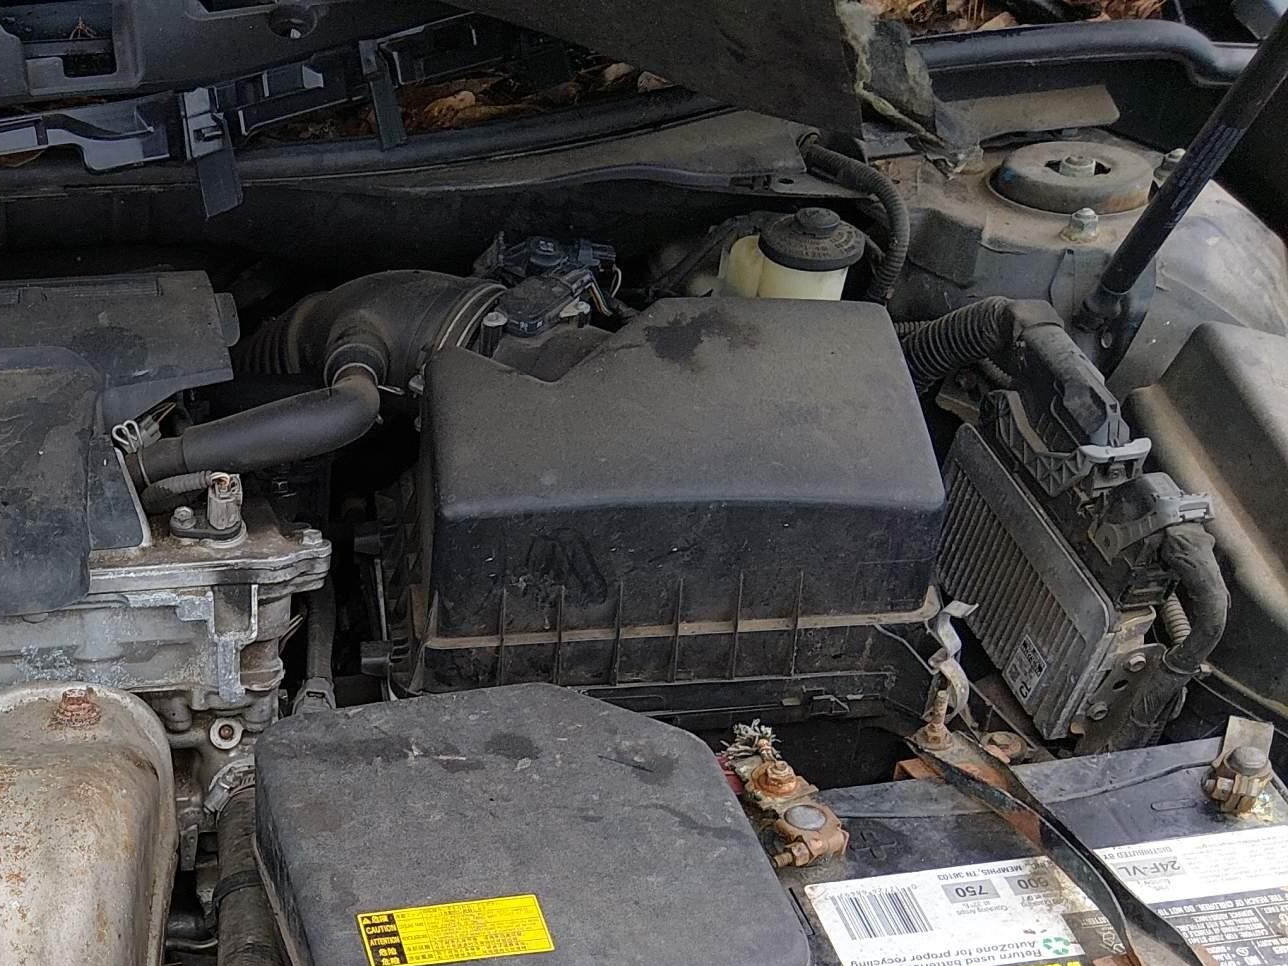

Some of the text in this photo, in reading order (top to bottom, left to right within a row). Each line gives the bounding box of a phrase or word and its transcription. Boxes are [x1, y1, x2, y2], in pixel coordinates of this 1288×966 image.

[1117, 846, 1173, 858] DISTRIBUTED
[1118, 860, 1181, 876] 24F-VL
[955, 885, 989, 898] 750
[365, 924, 397, 935] CAUTION
[370, 936, 401, 947] ATTENTION
[975, 940, 1037, 954] AutoZone
[909, 950, 952, 963] proper
[954, 949, 973, 957] for
[999, 948, 1043, 960] Return
[964, 955, 996, 966] used
